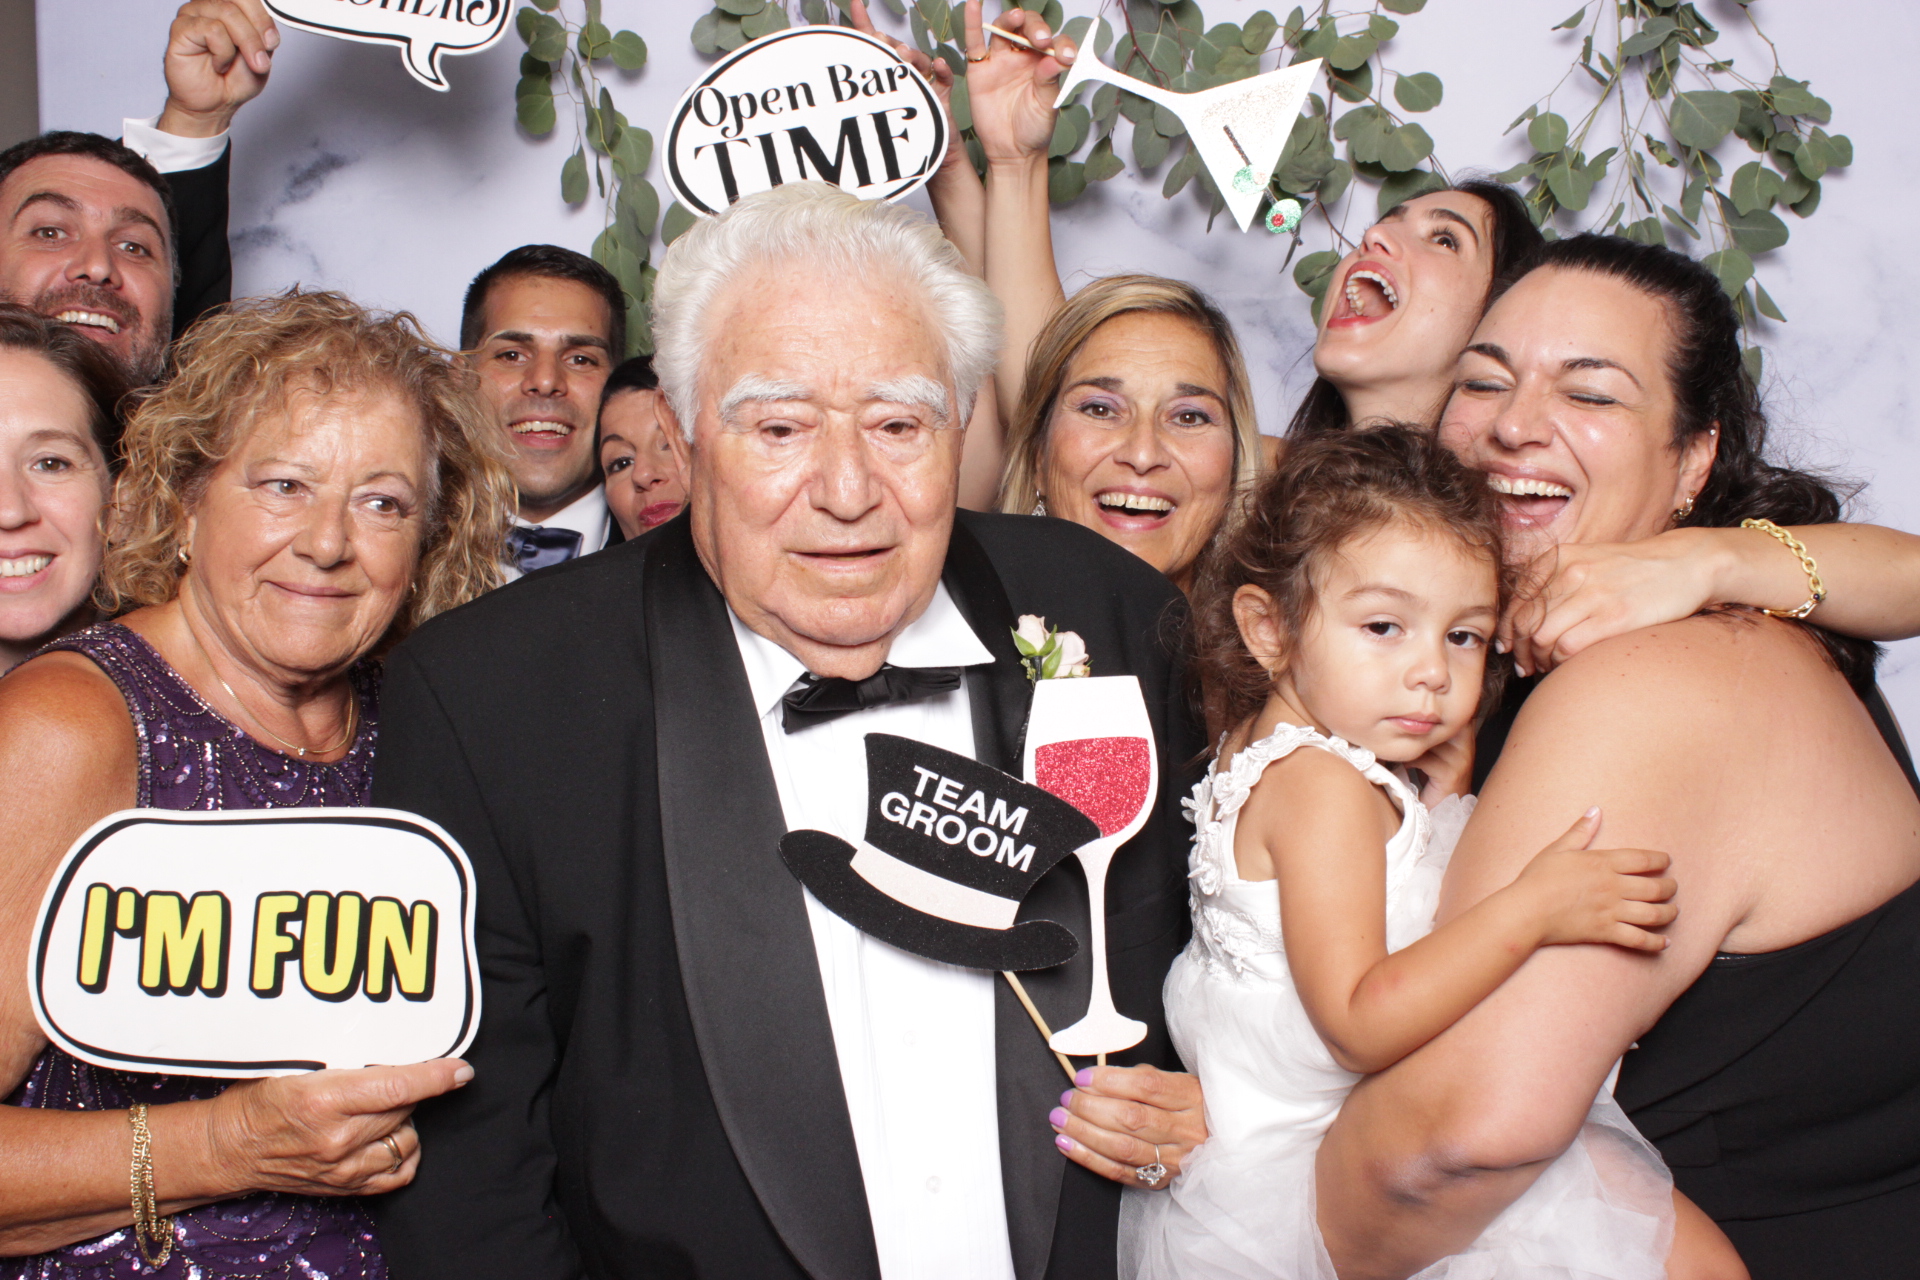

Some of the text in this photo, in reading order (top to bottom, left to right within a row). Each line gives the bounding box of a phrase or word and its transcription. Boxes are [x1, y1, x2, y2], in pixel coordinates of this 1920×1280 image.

[693, 64, 909, 138] Open Bar
[694, 107, 928, 205] TIME
[880, 791, 1037, 873] GROOM
[913, 765, 1029, 835] TEAM
[76, 882, 439, 1003] I'M FUN
